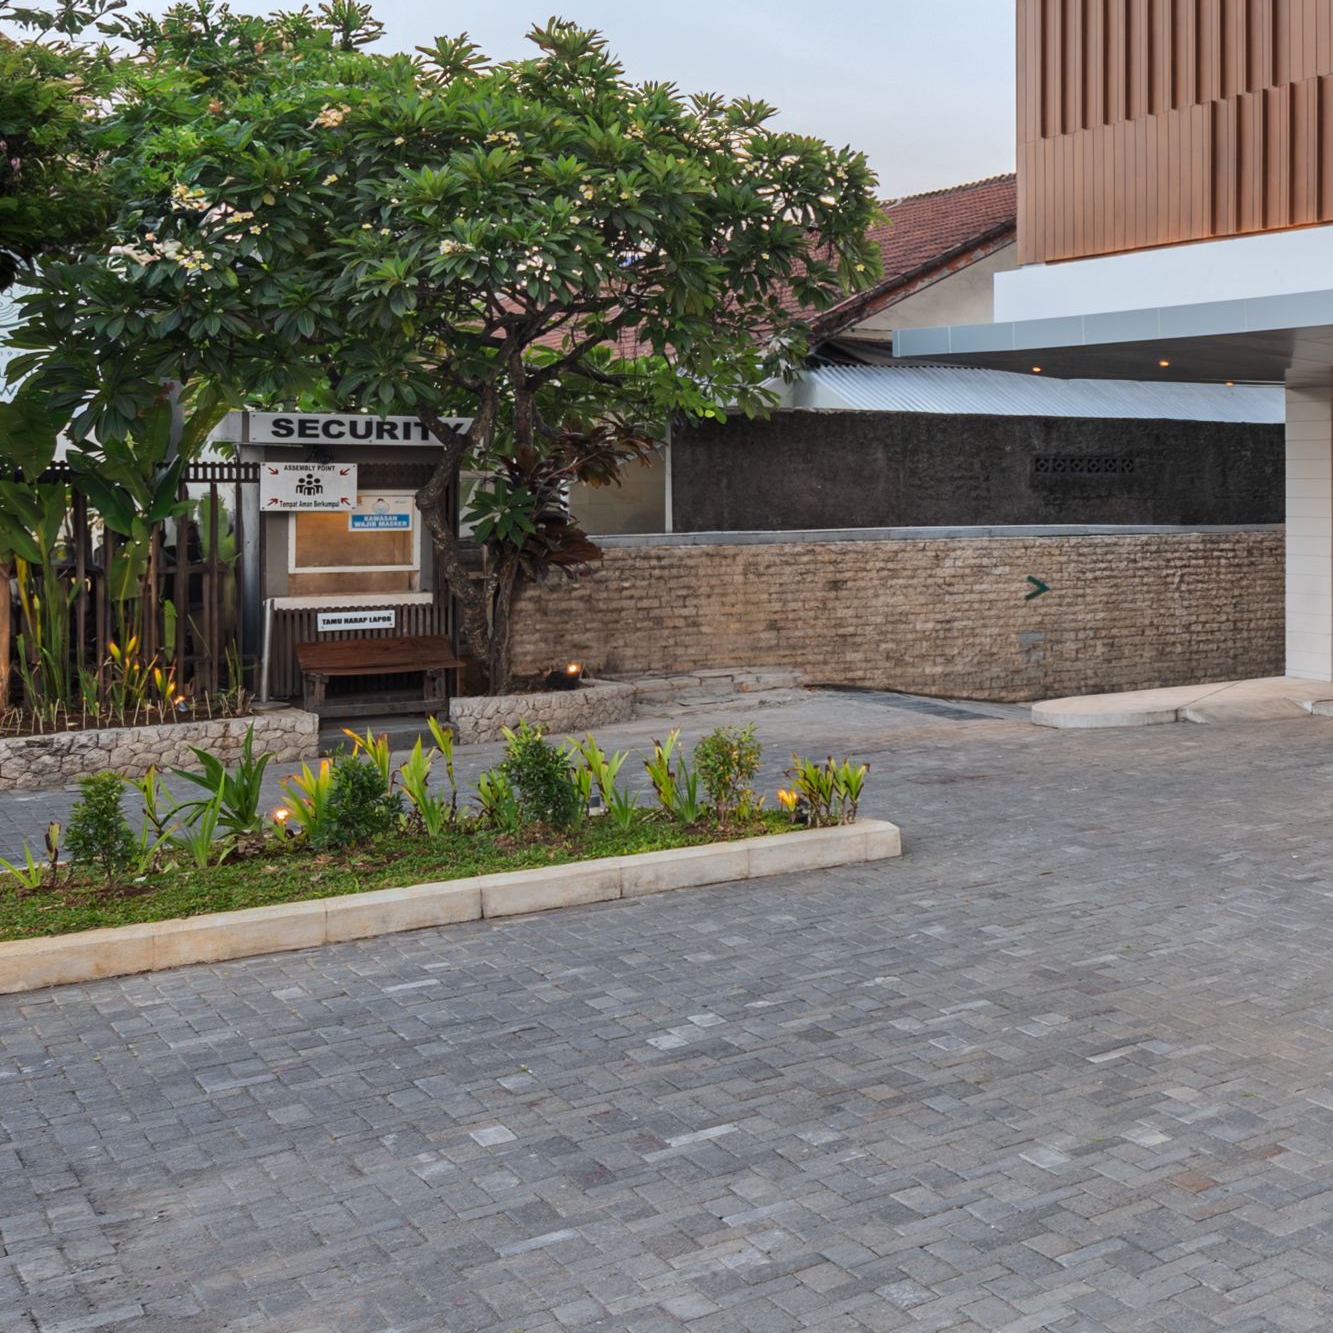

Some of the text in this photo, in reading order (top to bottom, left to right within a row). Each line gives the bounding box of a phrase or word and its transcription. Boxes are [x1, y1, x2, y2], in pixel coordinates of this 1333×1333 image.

[283, 464, 336, 472] ASSEMBLY POINT
[279, 500, 340, 509] Tempat Aman Berkumpul
